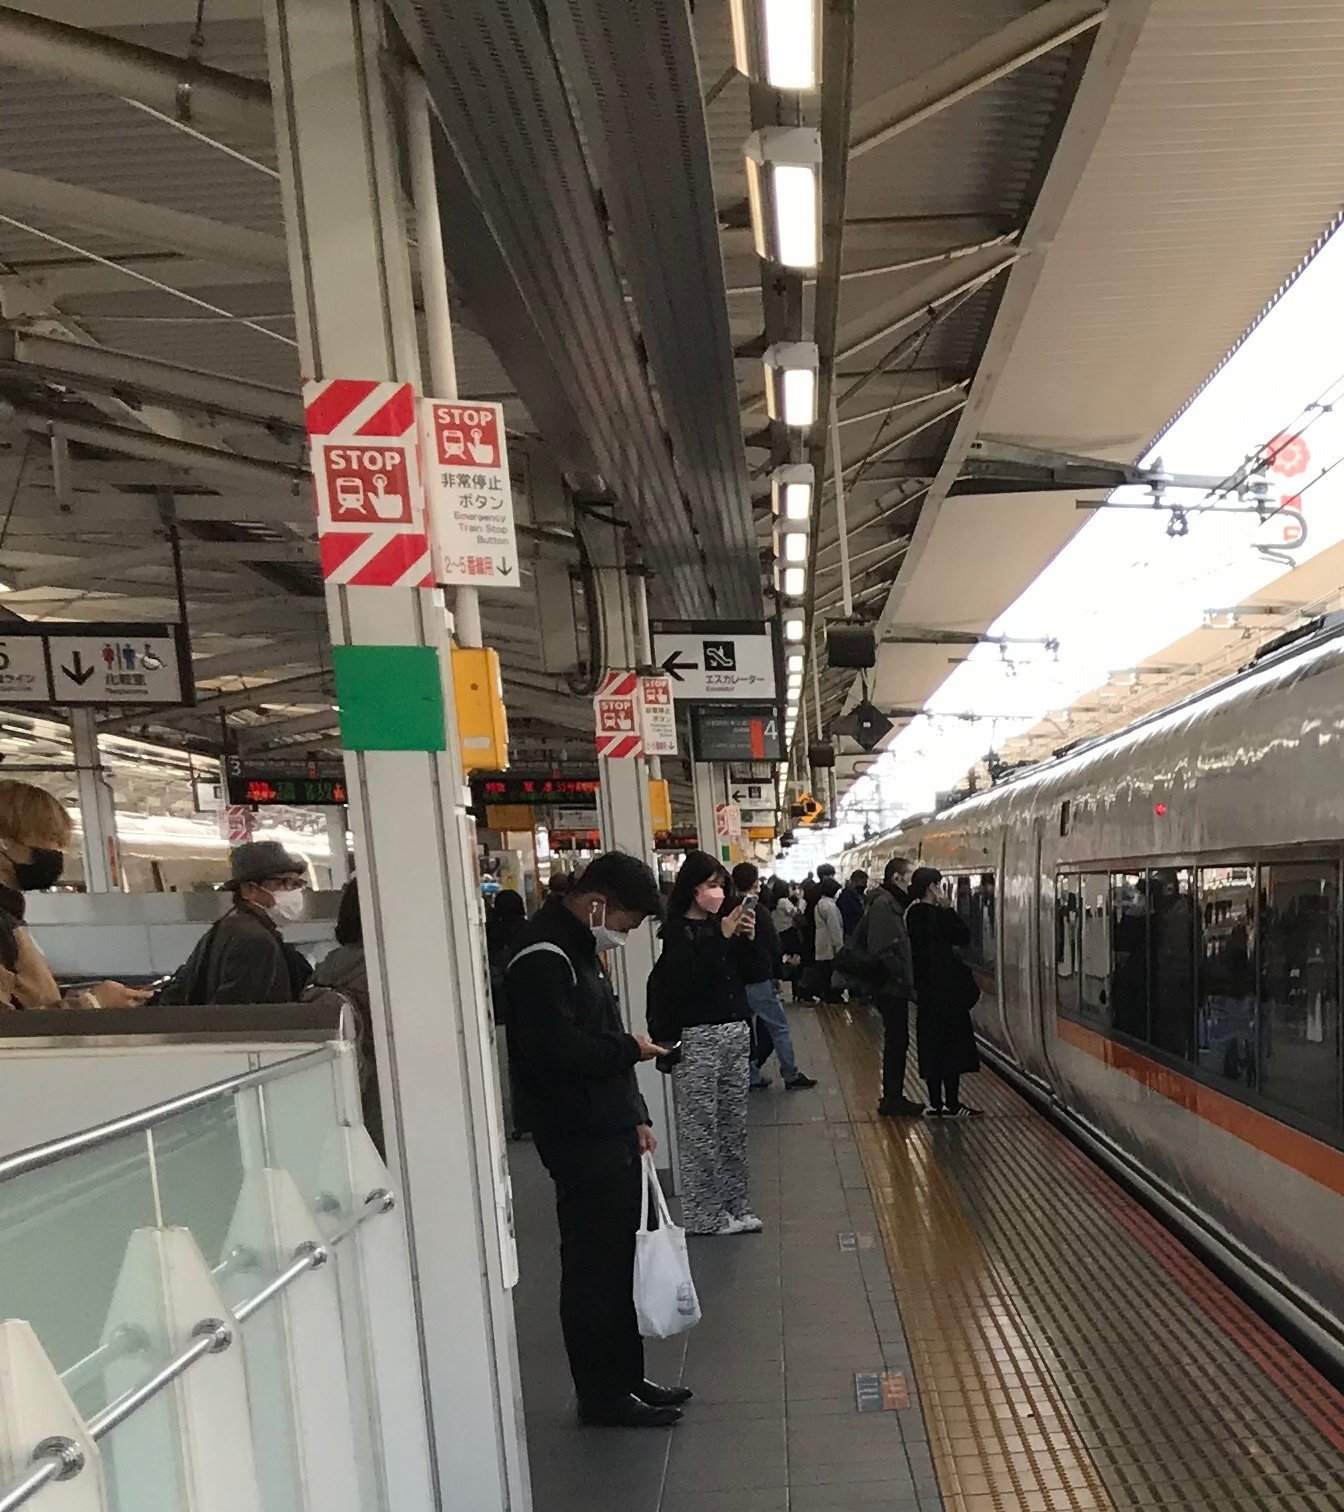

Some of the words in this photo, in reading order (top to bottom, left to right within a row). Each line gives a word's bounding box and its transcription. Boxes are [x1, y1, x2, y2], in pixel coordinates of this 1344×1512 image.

[437, 407, 493, 427] STOP
[329, 449, 401, 471] STOP
[441, 473, 503, 491] 非常停止
[458, 494, 504, 510] ボタン
[453, 510, 506, 523] Emergency
[458, 522, 483, 533] Train
[486, 524, 508, 535] Stop
[476, 535, 510, 545] Button
[705, 674, 765, 685] エスカレーター
[601, 701, 631, 711] STOP
[763, 719, 778, 740] 4
[230, 760, 242, 776] 3
